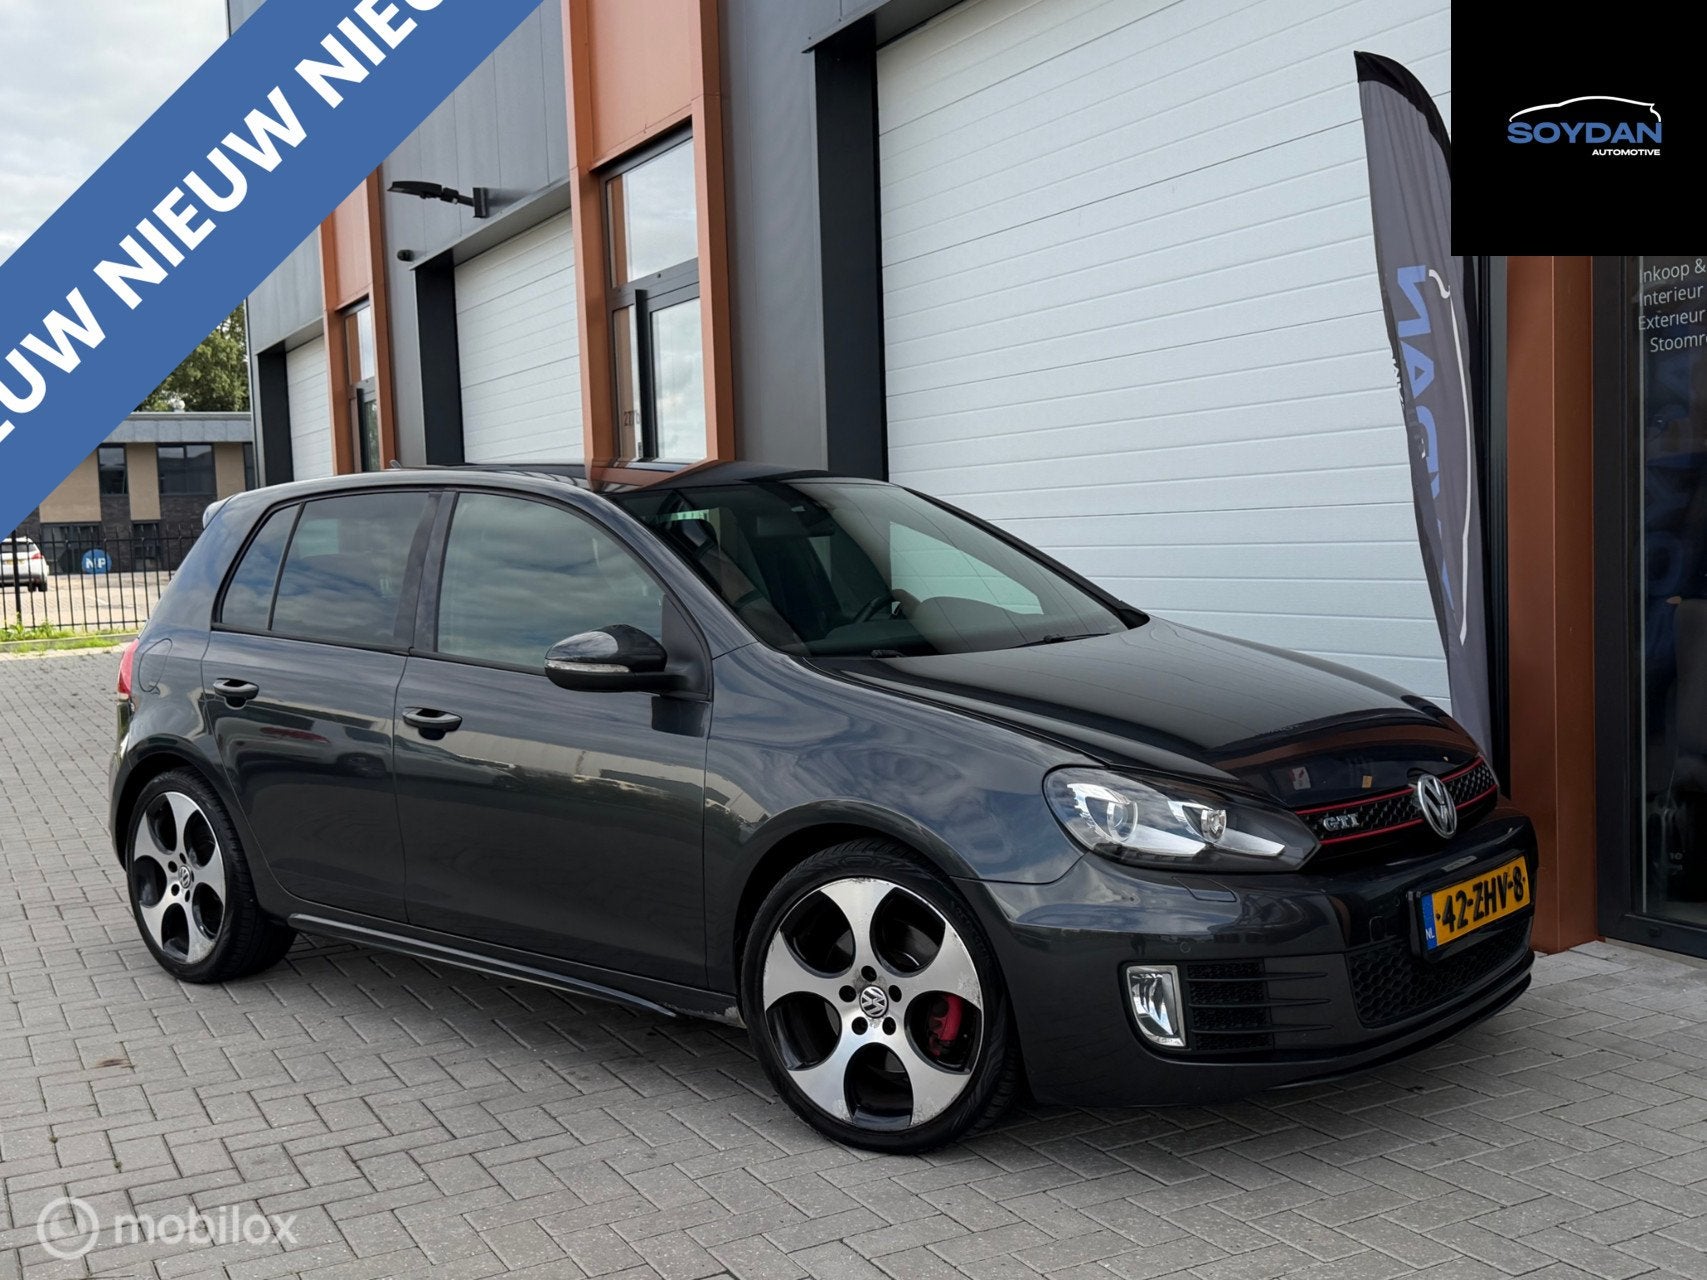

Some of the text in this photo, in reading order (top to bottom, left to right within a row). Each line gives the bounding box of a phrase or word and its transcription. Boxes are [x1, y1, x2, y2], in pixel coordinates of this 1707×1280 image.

[1695, 258, 1706, 274] &
[1640, 285, 1704, 306] Interieur
[1638, 309, 1706, 331] Exterieur
[1650, 333, 1707, 353] Stoomr
[1323, 813, 1360, 831] GTI
[1442, 866, 1524, 933] 42-ZHV-8
[1425, 927, 1436, 941] NL
